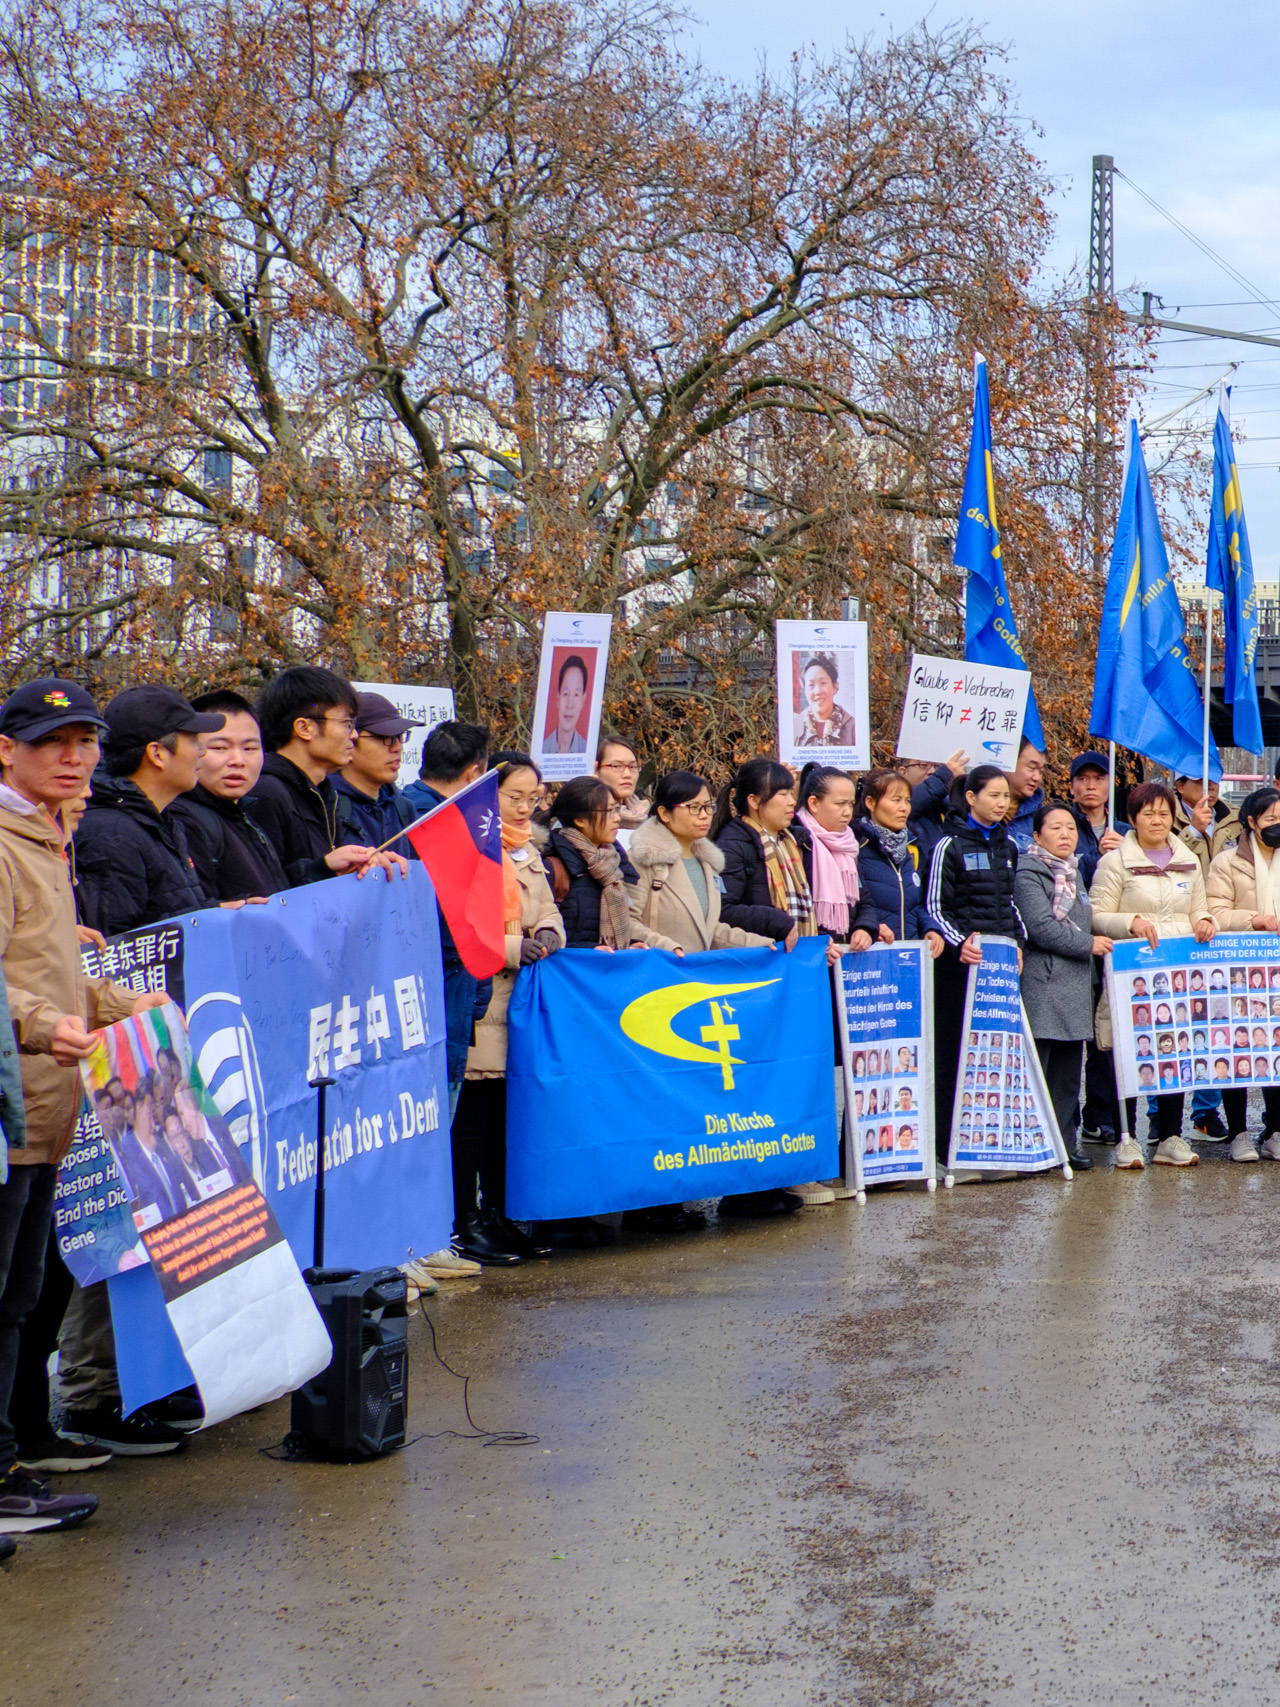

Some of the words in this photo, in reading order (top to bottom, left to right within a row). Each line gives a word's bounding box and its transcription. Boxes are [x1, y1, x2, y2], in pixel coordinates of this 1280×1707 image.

[966, 508, 990, 530] des
[914, 666, 949, 690] Glaube
[964, 674, 1014, 700] Verbrechen
[81, 930, 181, 979] 毛泽东罪行
[1190, 950, 1236, 960] CHRISTEN
[1238, 949, 1257, 958] DER
[1209, 939, 1239, 948] EINIGE
[1240, 938, 1259, 947] VON
[1260, 938, 1280, 946] DER
[896, 1000, 912, 1010] des
[356, 1106, 384, 1154] for
[388, 1110, 398, 1144] a
[705, 1115, 728, 1134] Die
[728, 1112, 775, 1132] Kirche
[58, 1145, 99, 1171] xpose
[654, 1150, 684, 1171] des
[687, 1136, 780, 1162] Allmächtigen
[782, 1132, 815, 1154] Gottes
[54, 1170, 103, 1200] Restore
[56, 1201, 81, 1227] End
[84, 1196, 106, 1217] the
[60, 1230, 96, 1254] Gene
